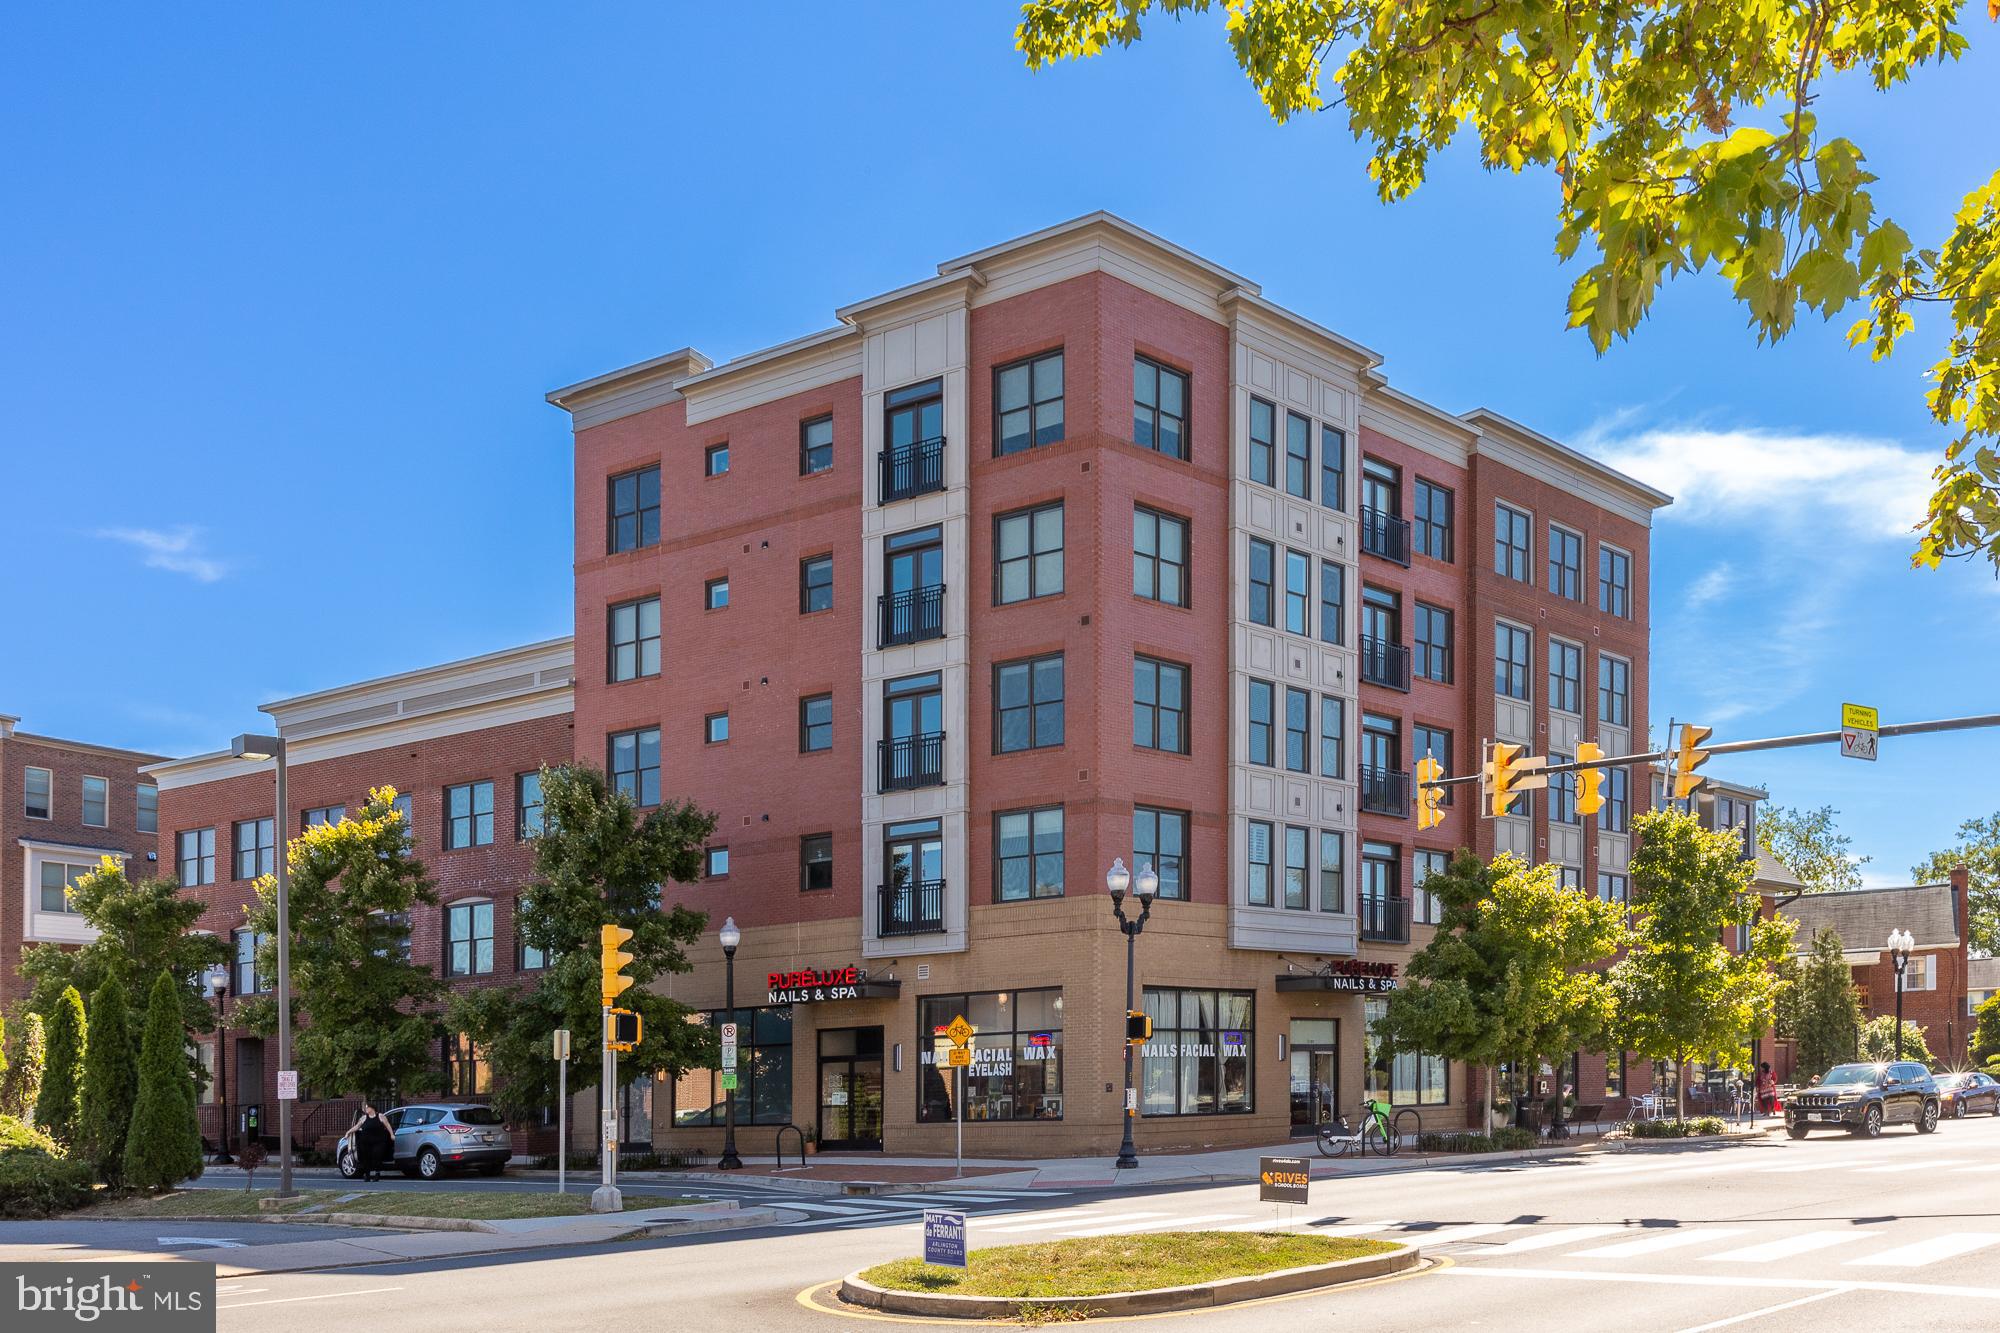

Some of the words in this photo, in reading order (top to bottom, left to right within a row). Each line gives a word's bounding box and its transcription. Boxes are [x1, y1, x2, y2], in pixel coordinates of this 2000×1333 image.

[1849, 708, 1872, 718] TURNING
[1847, 718, 1873, 728] VEHICLES
[1333, 978, 1365, 990] NAILS
[1368, 978, 1376, 990] &
[1380, 979, 1398, 991] SPA
[768, 990, 809, 1003] NAILS
[814, 989, 825, 1001] &
[831, 986, 857, 999] SPA
[1023, 1045, 1057, 1060] WAX
[1141, 1044, 1178, 1057] NAILS
[1180, 1044, 1216, 1057] FACIAL
[1223, 1044, 1247, 1057] WAX
[968, 1062, 1012, 1077] EYELASH
[1274, 1171, 1308, 1184] RIVES
[926, 1213, 943, 1223] MATT
[926, 1226, 933, 1237] de
[933, 1224, 964, 1240] FERRANTI
[927, 1246, 946, 1254] COUNTY
[947, 1248, 963, 1256] BOARD
[932, 1241, 958, 1250] ARLINGTON
